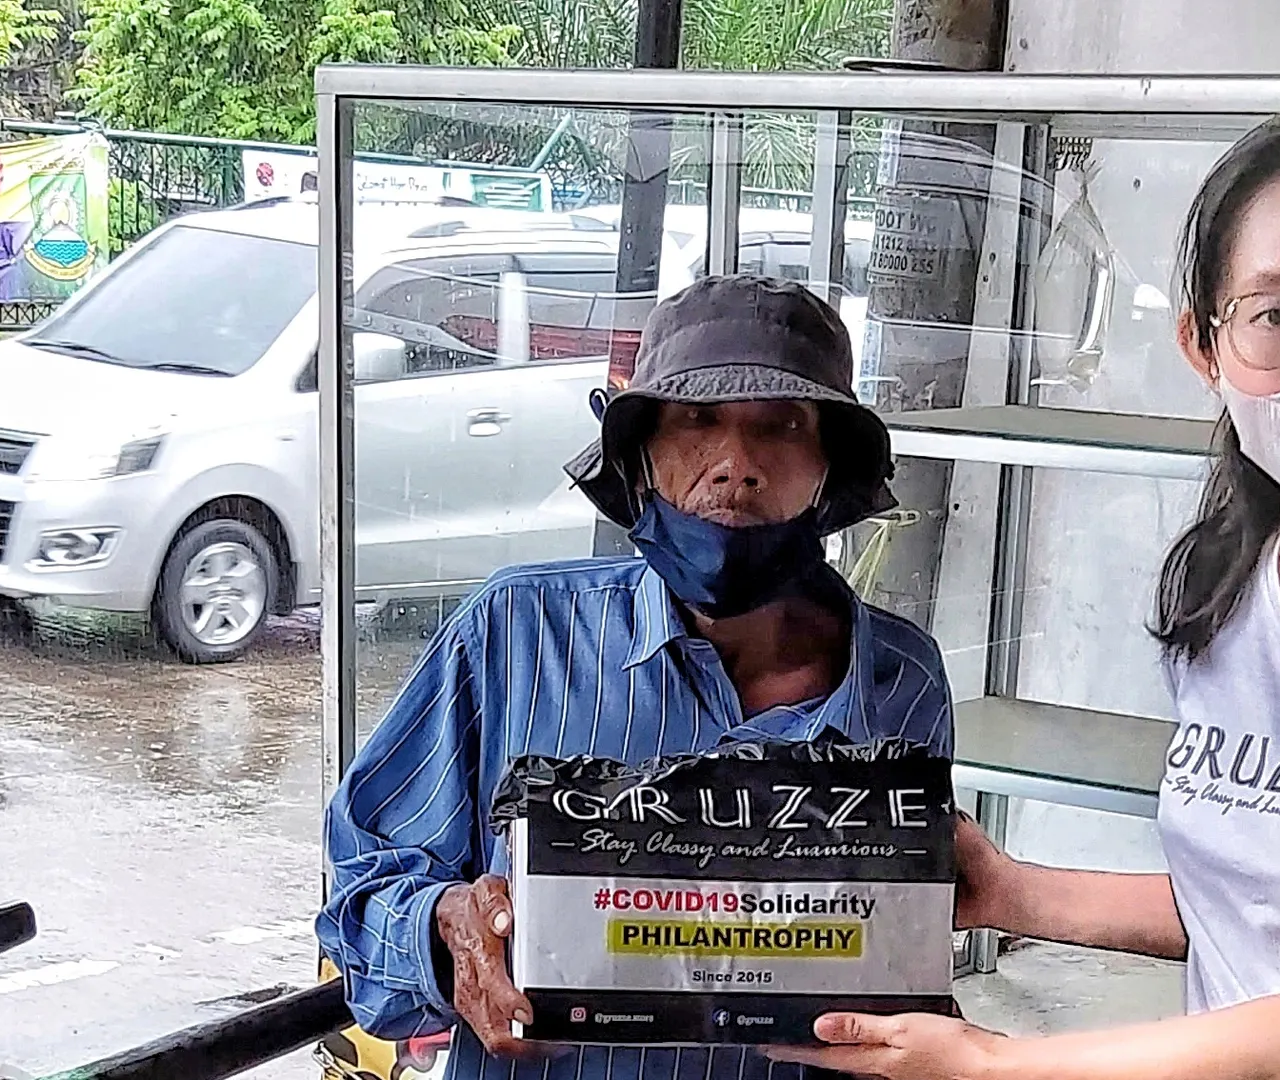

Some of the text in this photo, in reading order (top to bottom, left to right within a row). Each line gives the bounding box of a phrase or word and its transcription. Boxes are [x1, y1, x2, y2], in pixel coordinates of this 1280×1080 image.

[1172, 775, 1198, 806] Stay
[553, 786, 928, 829] GRUZZE
[581, 828, 898, 868] Stay Classy and Luxurious
[594, 888, 876, 919] #COVID19Solidarity
[622, 925, 856, 950] PHILANTROPHY
[692, 969, 773, 983] Since 2015
